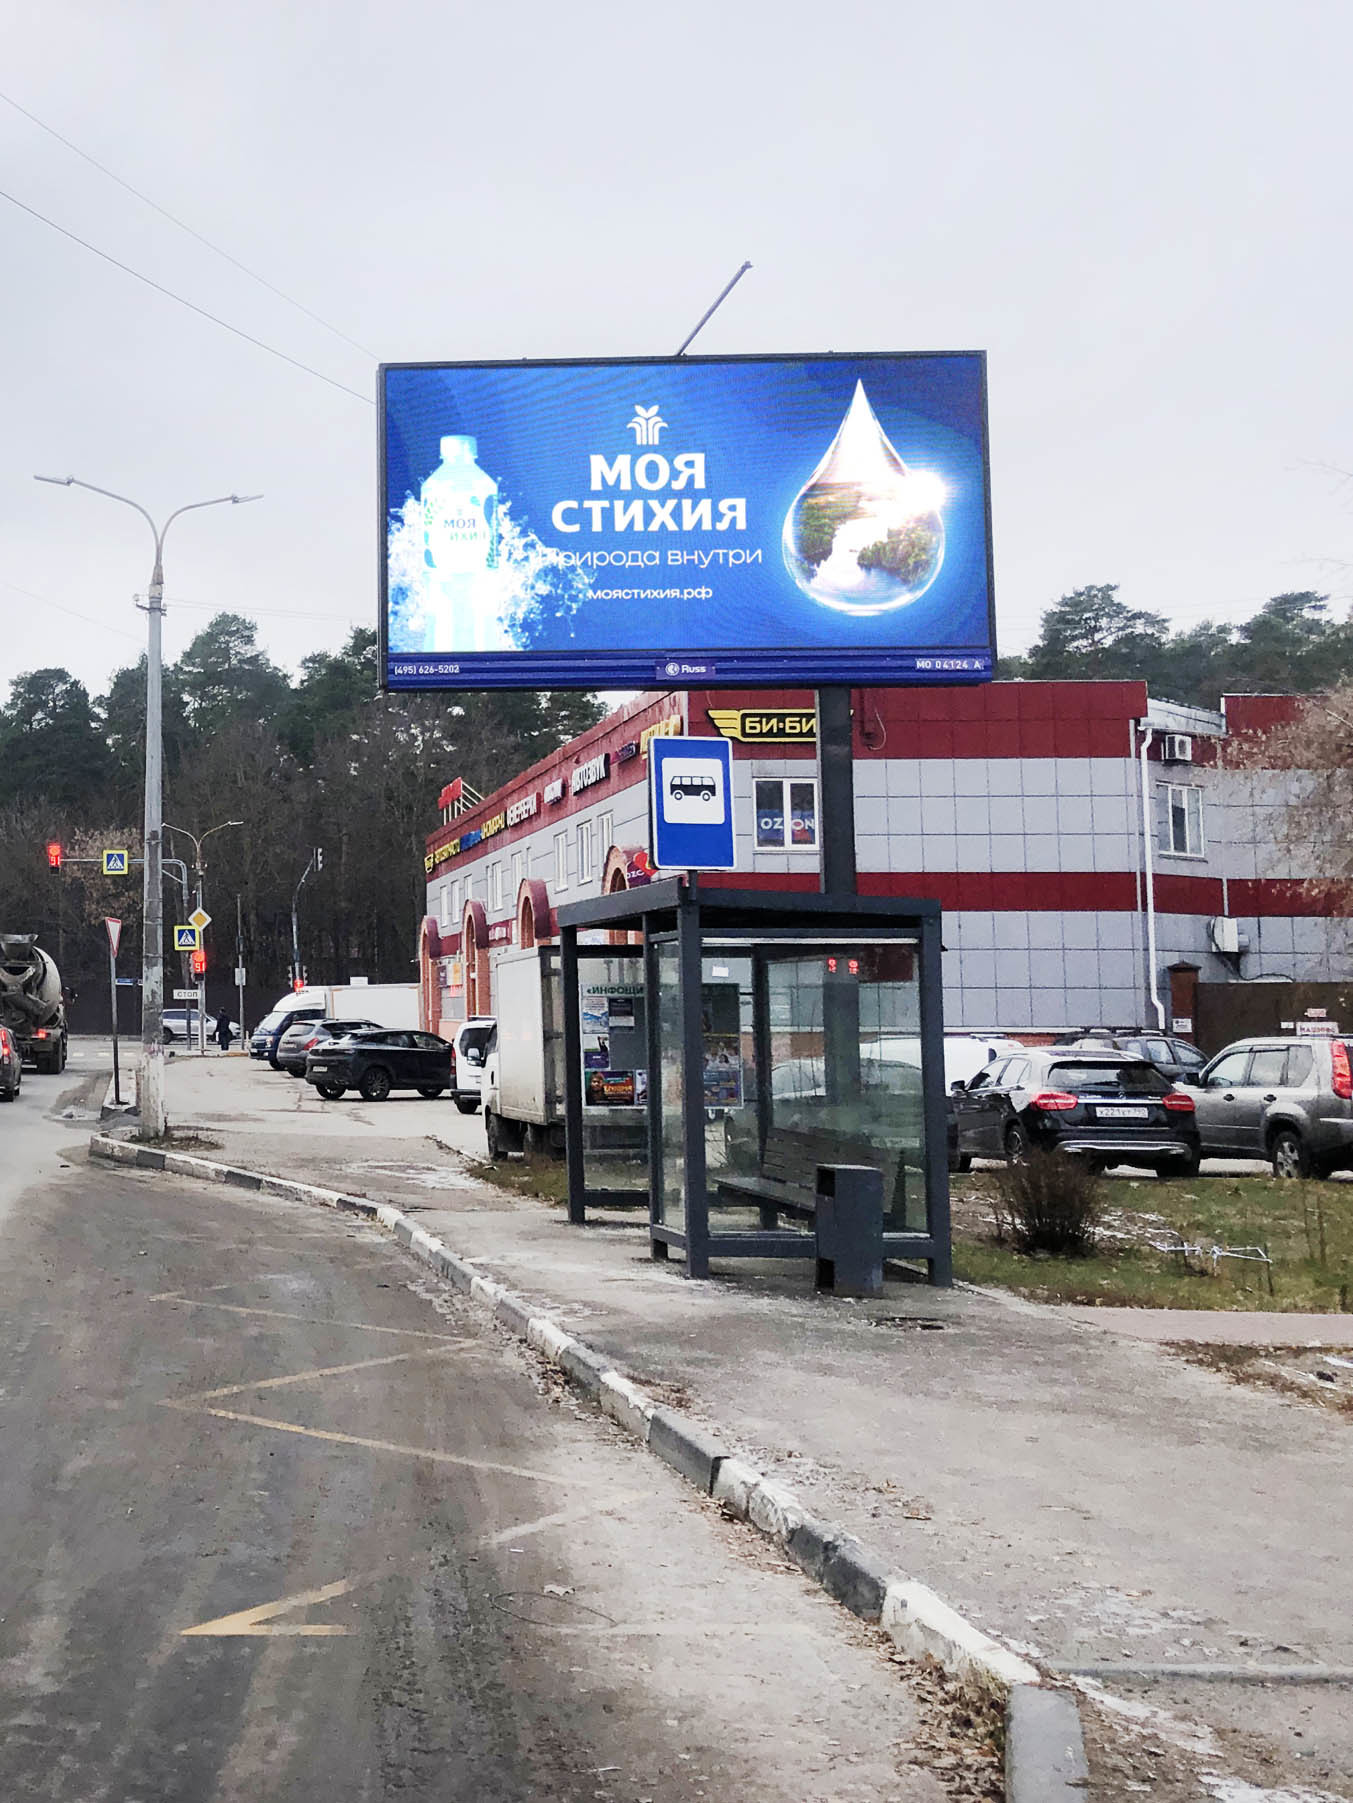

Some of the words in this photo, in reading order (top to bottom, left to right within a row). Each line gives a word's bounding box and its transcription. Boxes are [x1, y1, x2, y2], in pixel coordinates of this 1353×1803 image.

[589, 452, 706, 491] МОЯ
[551, 497, 747, 533] СТИХИЯ
[541, 550, 660, 569] рирода
[667, 548, 763, 568] внутри
[589, 586, 713, 601] моястихия.рф
[394, 665, 417, 675] (495)
[418, 664, 460, 674] 626-5202
[681, 664, 707, 673] Russ
[586, 984, 644, 995] «ИНФОЩИ
